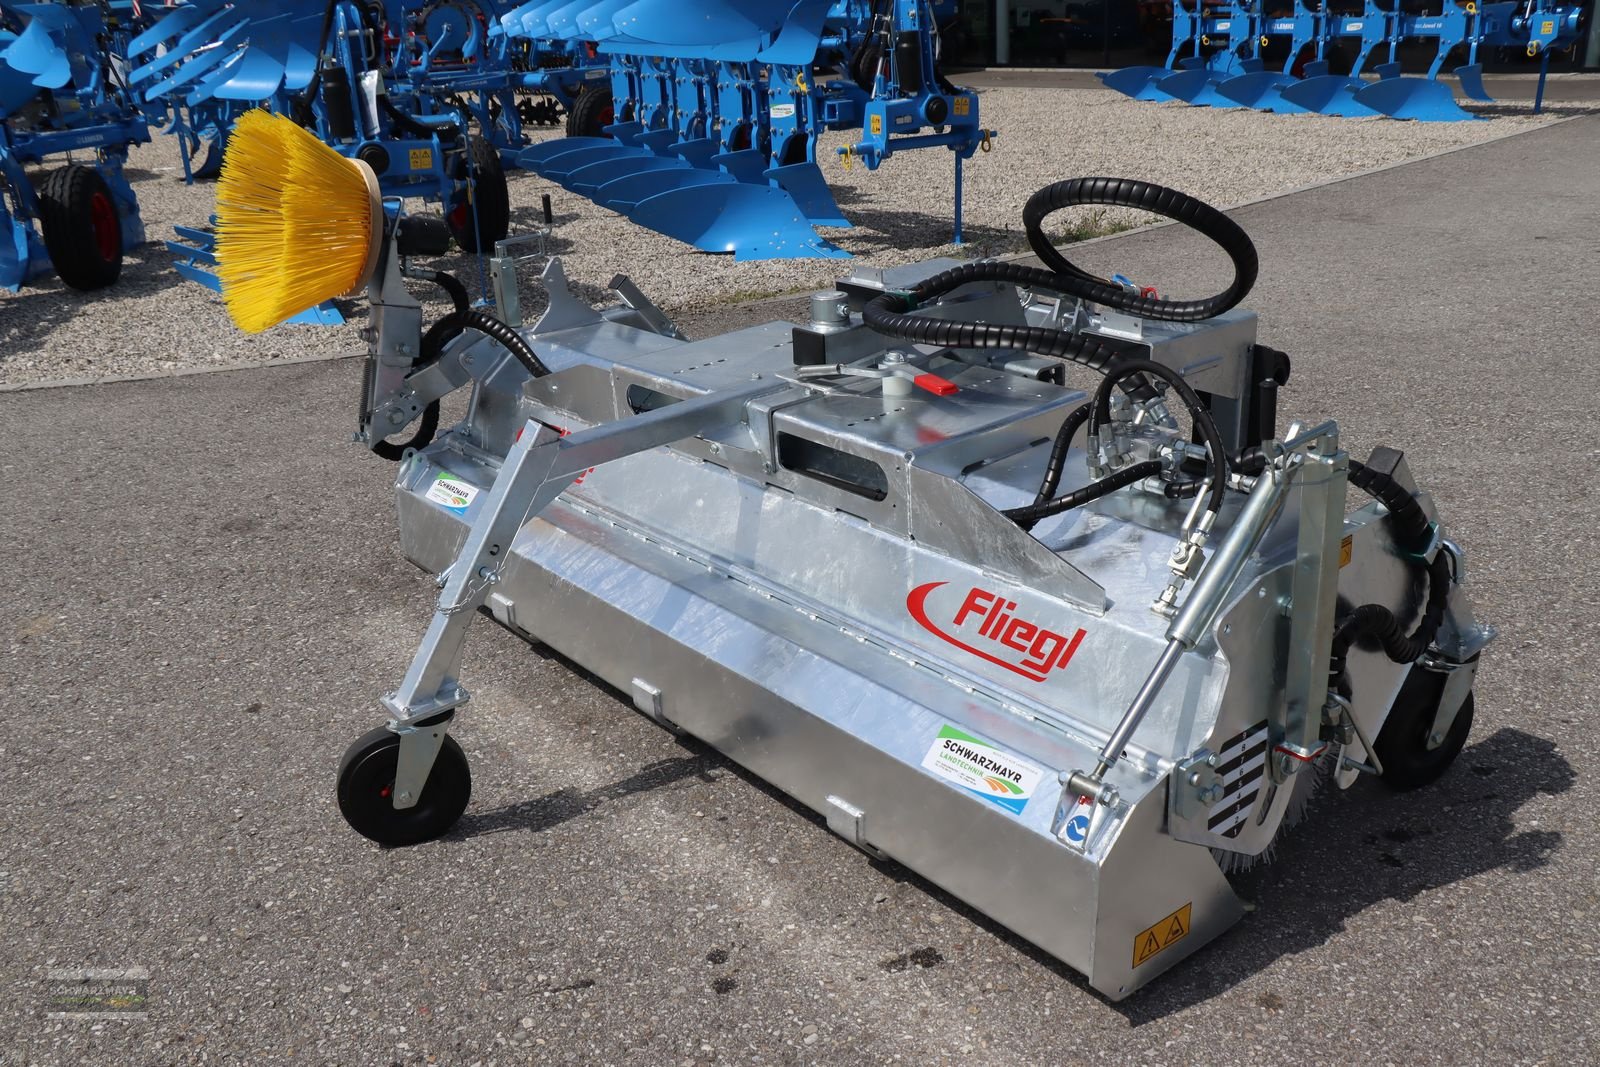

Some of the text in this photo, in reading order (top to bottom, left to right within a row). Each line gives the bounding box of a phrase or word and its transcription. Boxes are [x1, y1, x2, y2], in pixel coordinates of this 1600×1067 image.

[953, 587, 1087, 674] Fliegl
[939, 751, 985, 778] LANDTECHNIK
[943, 739, 1023, 783] SCHWARZMAYR
